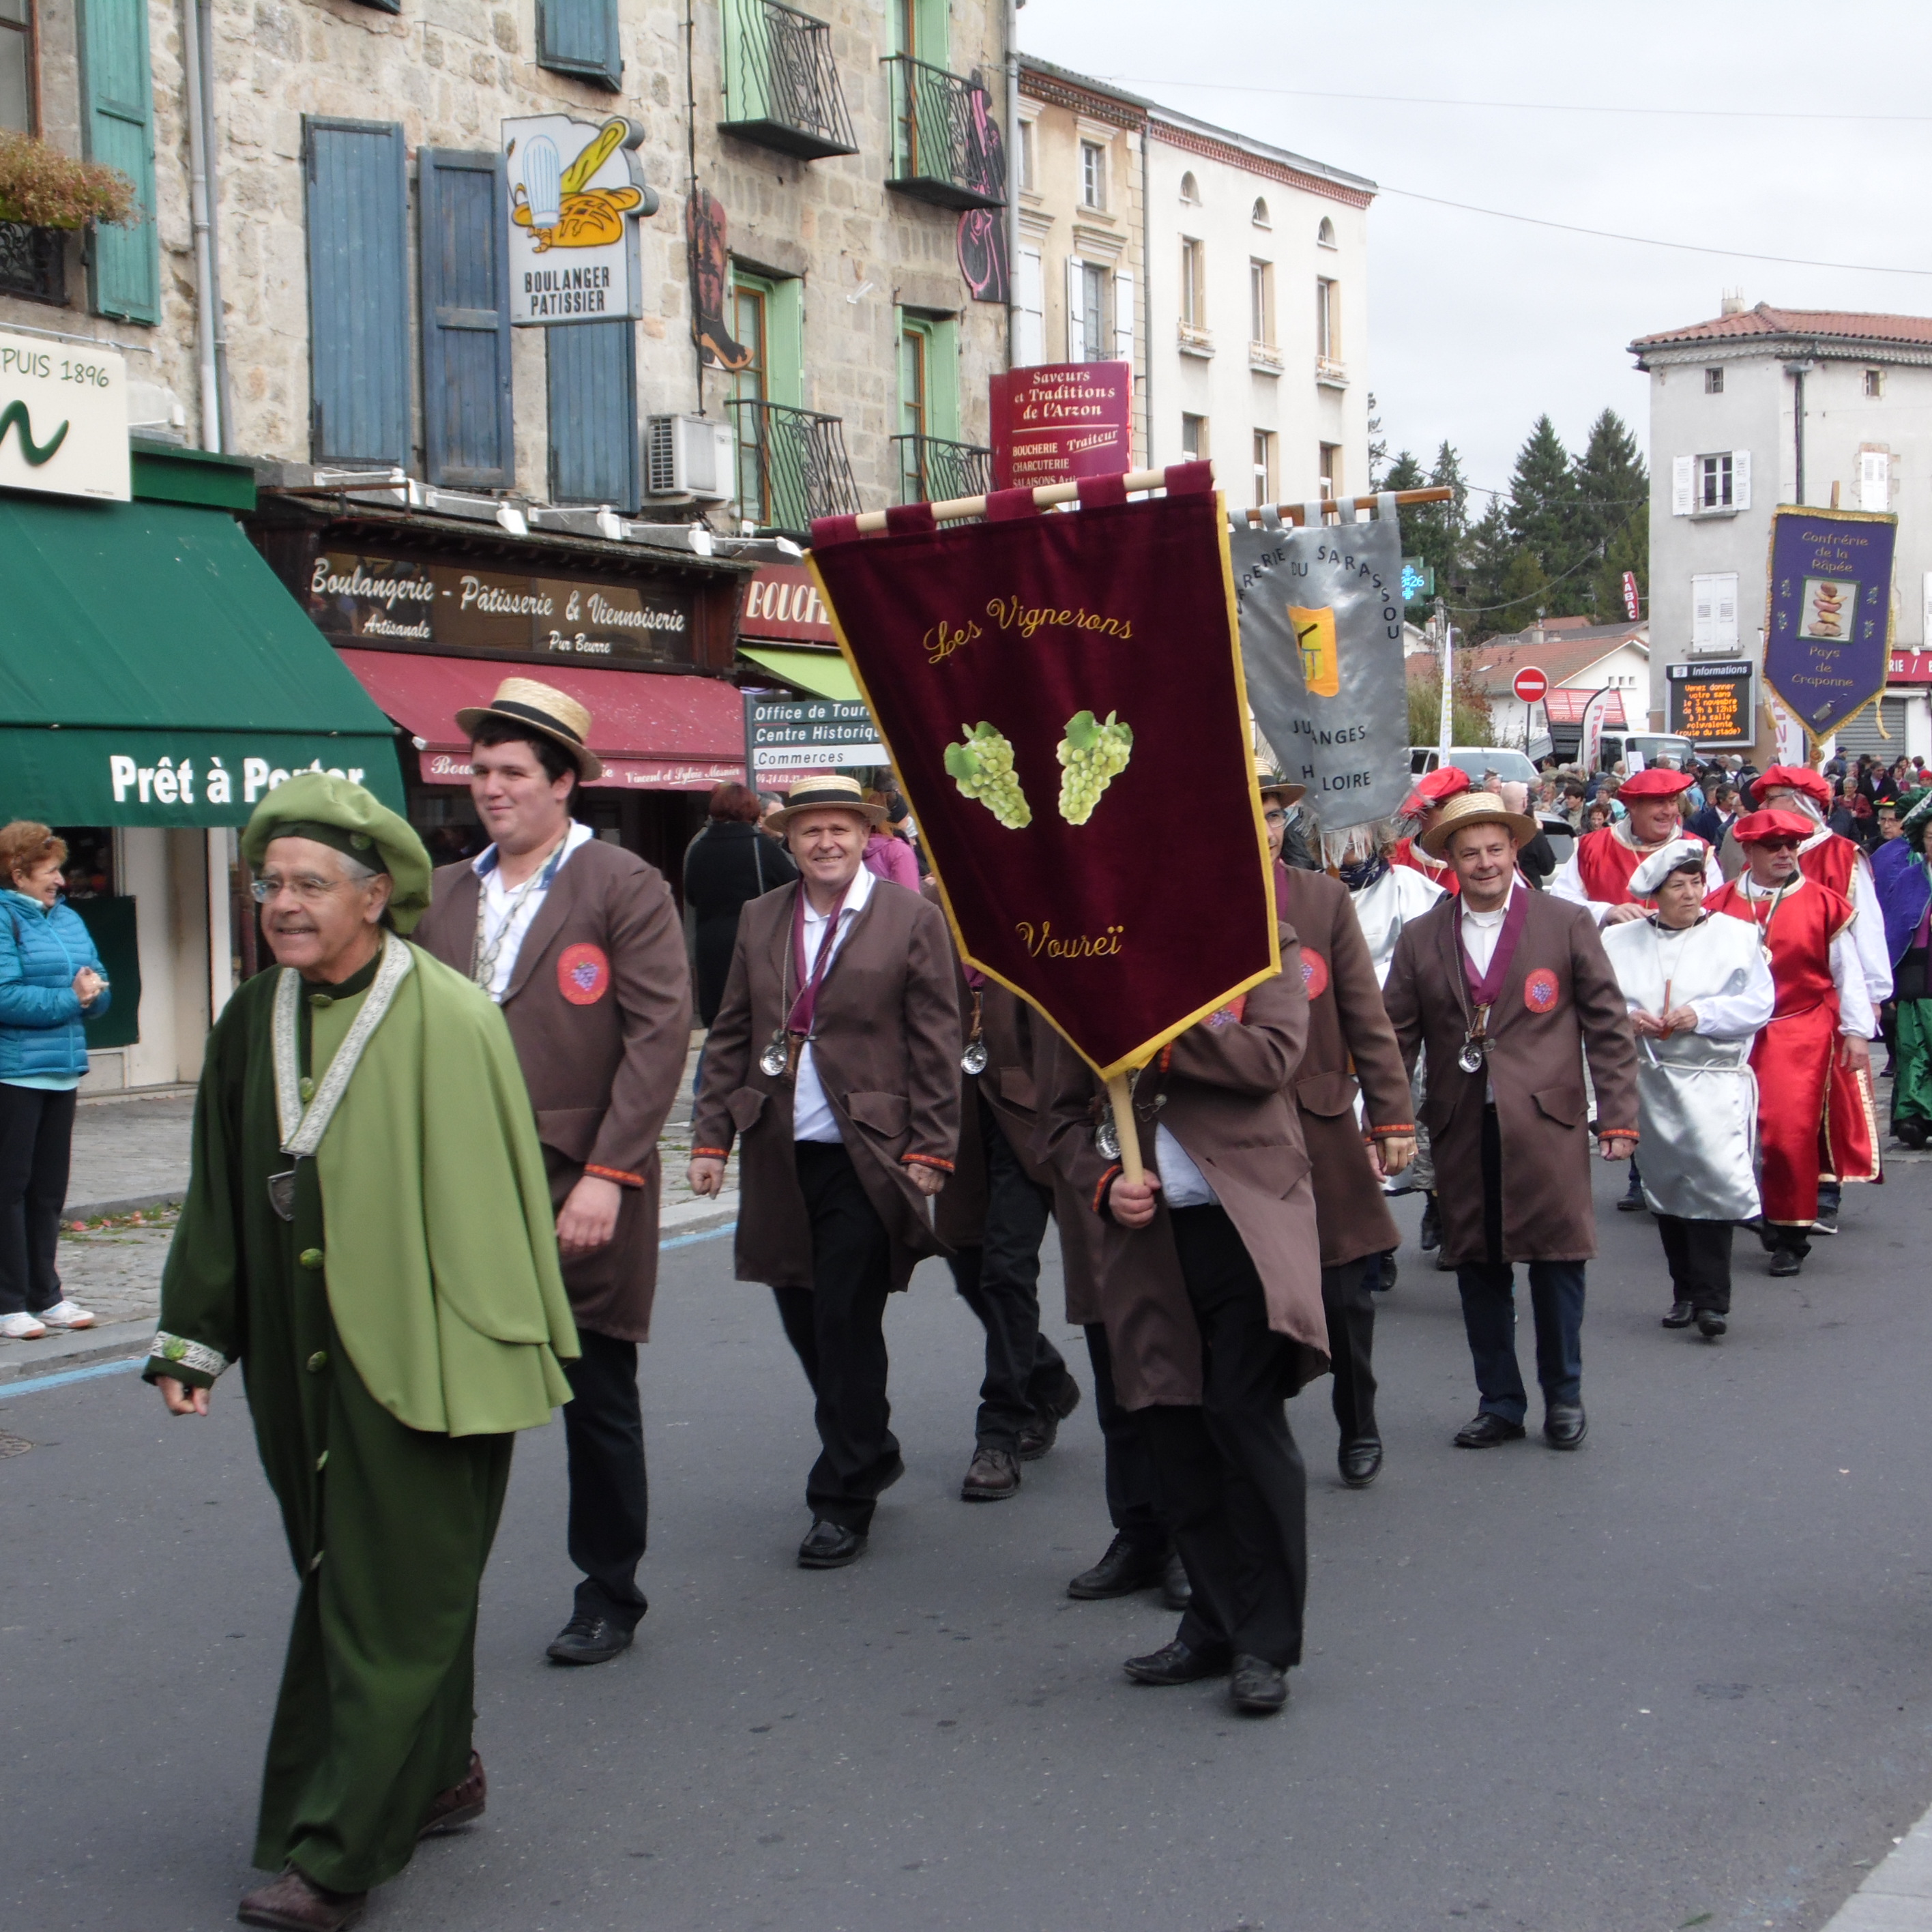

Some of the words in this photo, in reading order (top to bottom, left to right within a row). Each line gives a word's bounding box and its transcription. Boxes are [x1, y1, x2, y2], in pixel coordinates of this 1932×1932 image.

[525, 267, 610, 293] BOULANGER
[531, 290, 604, 316] PATISSIER
[61, 360, 109, 387] 1896
[1032, 371, 1090, 384] Saveurs
[1014, 392, 1023, 403] et
[1029, 384, 1115, 401] Traditions
[1023, 405, 1038, 420] de
[1043, 402, 1102, 418] l'Arzon
[1012, 442, 1057, 457] BOUCHERIE
[1067, 430, 1118, 452] Traiteur
[1012, 458, 1070, 473] CHARCUTERIE
[1012, 475, 1056, 488] SALAISONS
[1801, 531, 1869, 546] Confrérie
[1815, 547, 1832, 558] de
[1836, 547, 1848, 559] la
[1811, 559, 1853, 574] Râpée
[311, 557, 434, 610] Boulangerie
[460, 576, 553, 616] Pâtisserie
[566, 589, 579, 621] &
[587, 593, 685, 631] Viennoiserie
[1317, 546, 1399, 639] SARASSOU
[1623, 574, 1636, 619] TABAC
[362, 614, 430, 639] Artisanale
[924, 621, 982, 664] Les
[986, 596, 1133, 639] Vignerons
[548, 630, 572, 651] Pur
[574, 632, 611, 654] Beurre
[1809, 647, 1840, 660] Pays
[1693, 666, 1747, 676] Informations
[1815, 662, 1832, 673] de
[1709, 683, 1736, 691] donner
[1791, 674, 1854, 688] Craponne
[1703, 697, 1738, 705] novembre
[755, 706, 802, 720] Office
[808, 705, 825, 718] de
[1710, 713, 1731, 721] salle
[1686, 721, 1733, 729] polyvalente
[756, 728, 806, 742] Centre
[431, 755, 473, 774] Bou
[758, 752, 844, 765] Commerces
[111, 755, 194, 804] Prêt
[207, 757, 231, 803] à
[625, 770, 660, 783] Vincent
[1322, 772, 1371, 791] LOIRE
